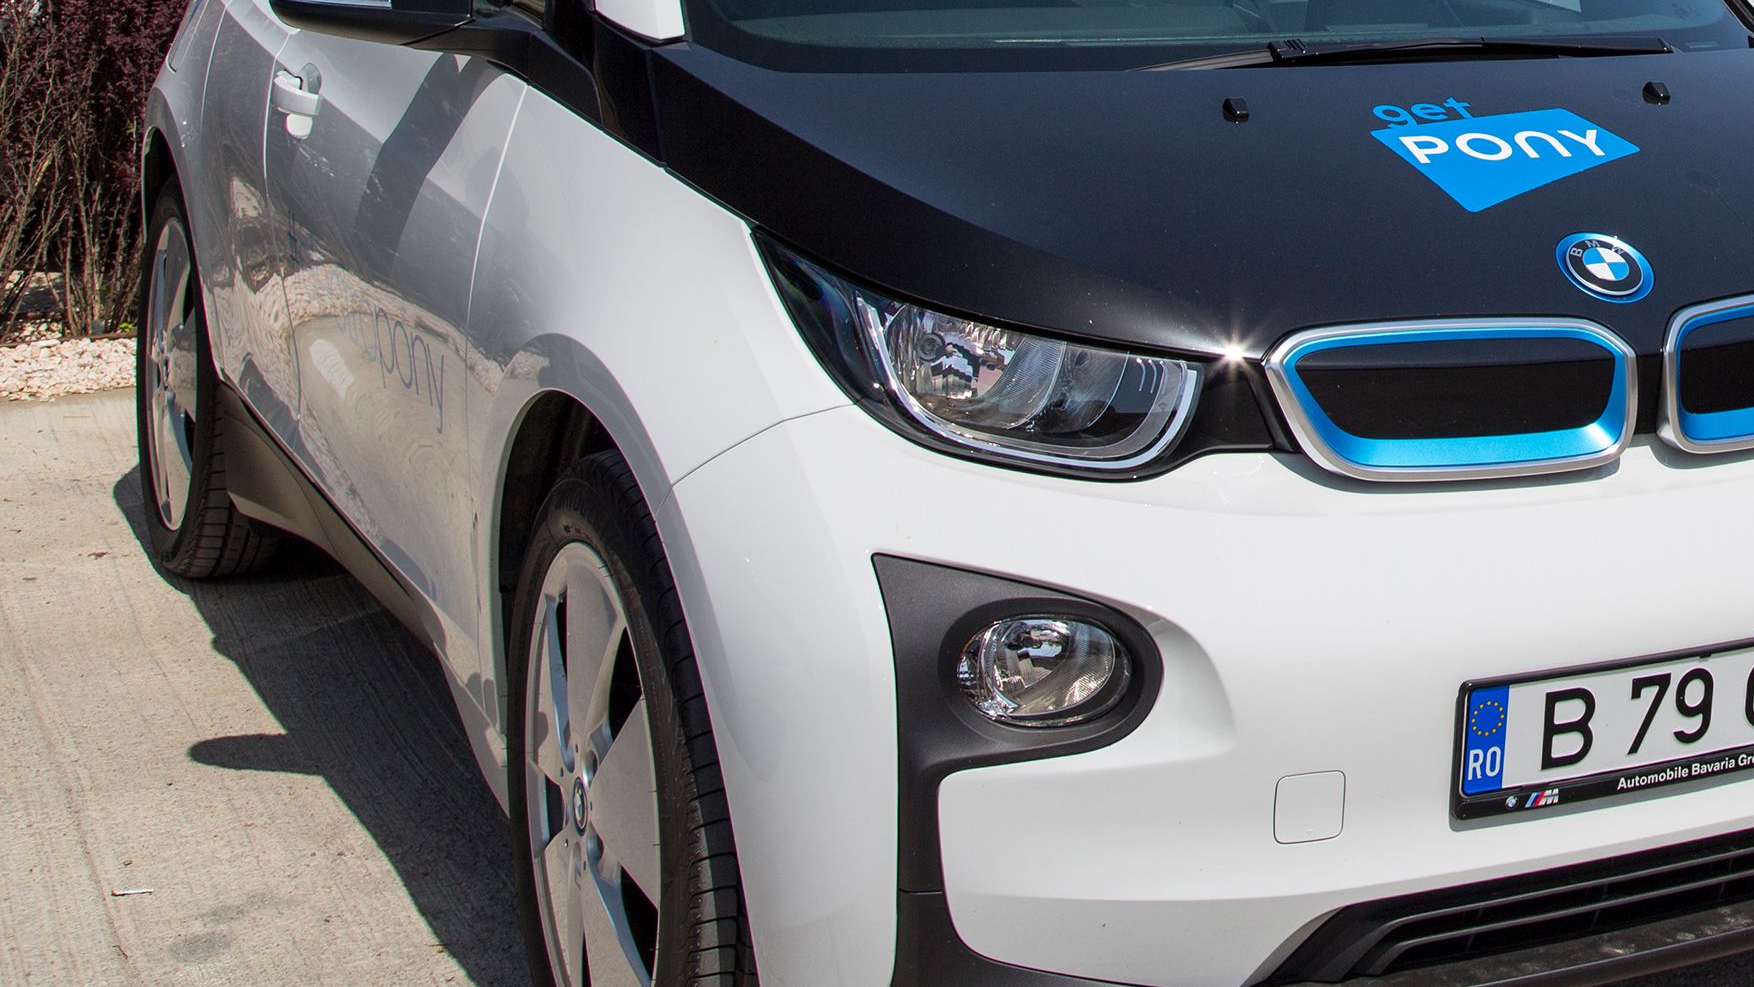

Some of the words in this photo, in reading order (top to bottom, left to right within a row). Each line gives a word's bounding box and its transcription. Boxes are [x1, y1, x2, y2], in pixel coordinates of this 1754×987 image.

[1372, 97, 1474, 128] get
[1398, 128, 1607, 164] PONY
[1569, 239, 1626, 258] BMW
[374, 303, 445, 434] pony
[1541, 686, 1597, 771] B
[1627, 667, 1715, 755] 79
[1467, 746, 1501, 781] RO
[1616, 766, 1689, 791] Automobile
[1691, 756, 1736, 775] Bavaria
